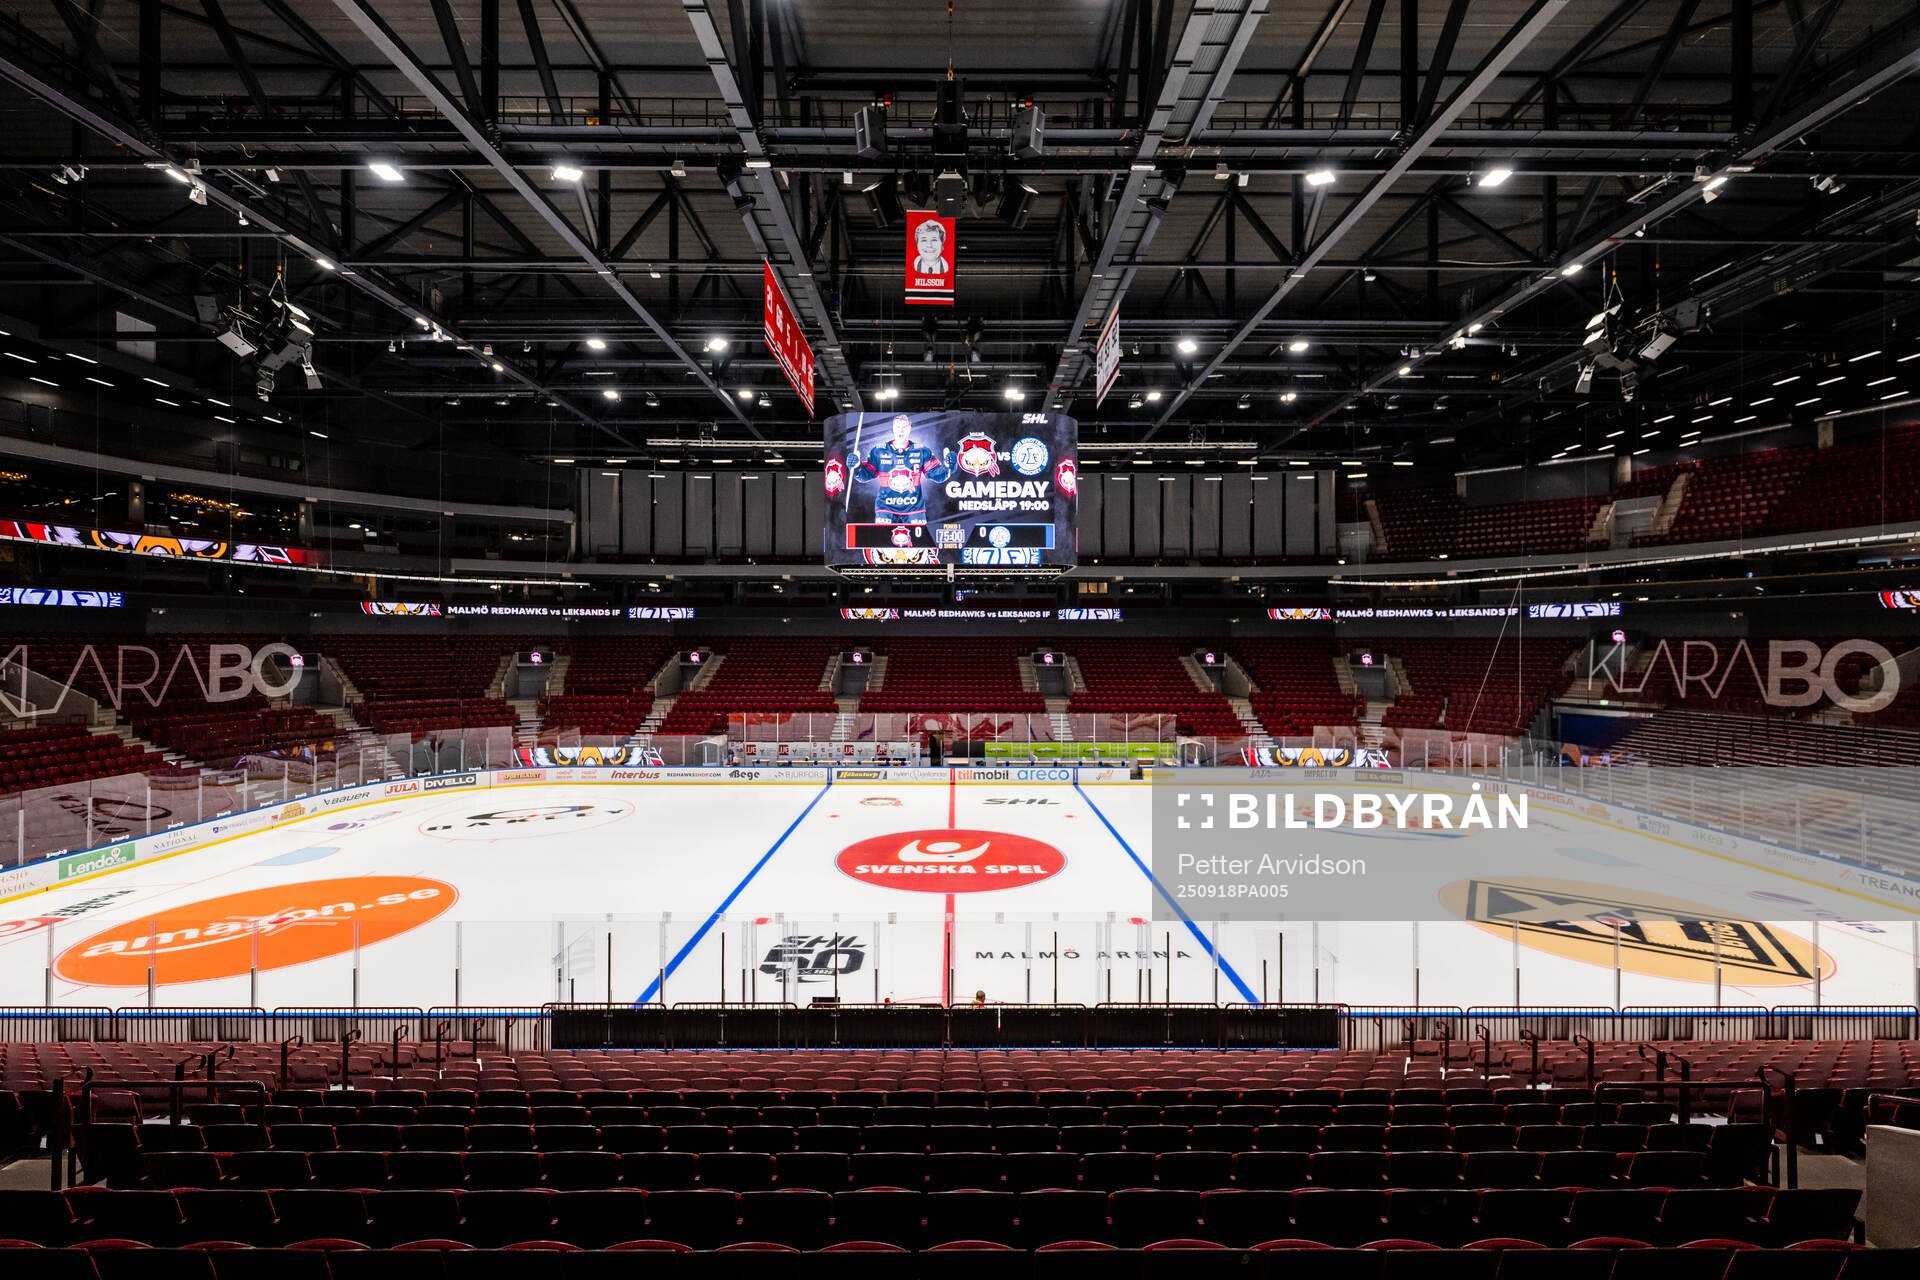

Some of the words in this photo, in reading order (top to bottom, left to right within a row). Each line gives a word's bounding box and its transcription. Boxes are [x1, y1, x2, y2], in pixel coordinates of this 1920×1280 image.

[915, 278, 945, 287] NILSSON
[1022, 413, 1048, 424] SHL
[945, 481, 1049, 498] GAMEDAY
[885, 497, 917, 505] areco
[959, 498, 1017, 510] NEDSLÄPP
[1019, 501, 1049, 510] 19:00
[915, 527, 921, 537] 0
[938, 531, 963, 542] 75:00
[980, 527, 986, 537] 0
[447, 605, 488, 615] MALMÖ
[491, 607, 548, 616] REDHAWKS
[562, 608, 610, 616] LEKSANDS
[903, 608, 937, 617] MALMÖ
[938, 610, 985, 618] REDHAWKS
[998, 610, 1041, 618] LEKSANDS
[1336, 608, 1374, 618] MALMÖ
[1375, 609, 1433, 618] REDHAWKS
[1449, 608, 1506, 617] LEKSANDS
[1507, 607, 1518, 616] IF
[1588, 638, 1900, 713] KLARABO
[611, 770, 660, 779] Interbus
[958, 769, 1009, 780] tillmobil
[1017, 769, 1069, 781] areco
[1304, 770, 1327, 778] IMPACT
[1329, 770, 1337, 778] BY
[425, 777, 475, 788] DIVELLO
[386, 783, 417, 794] JULA
[153, 835, 197, 850] NATIONAL
[1763, 847, 1817, 866] ticketmaster
[854, 864, 976, 874] SVENSKA
[984, 864, 1048, 874] SPEL
[773, 935, 867, 948] SHL
[1097, 951, 1192, 959] ARENA
